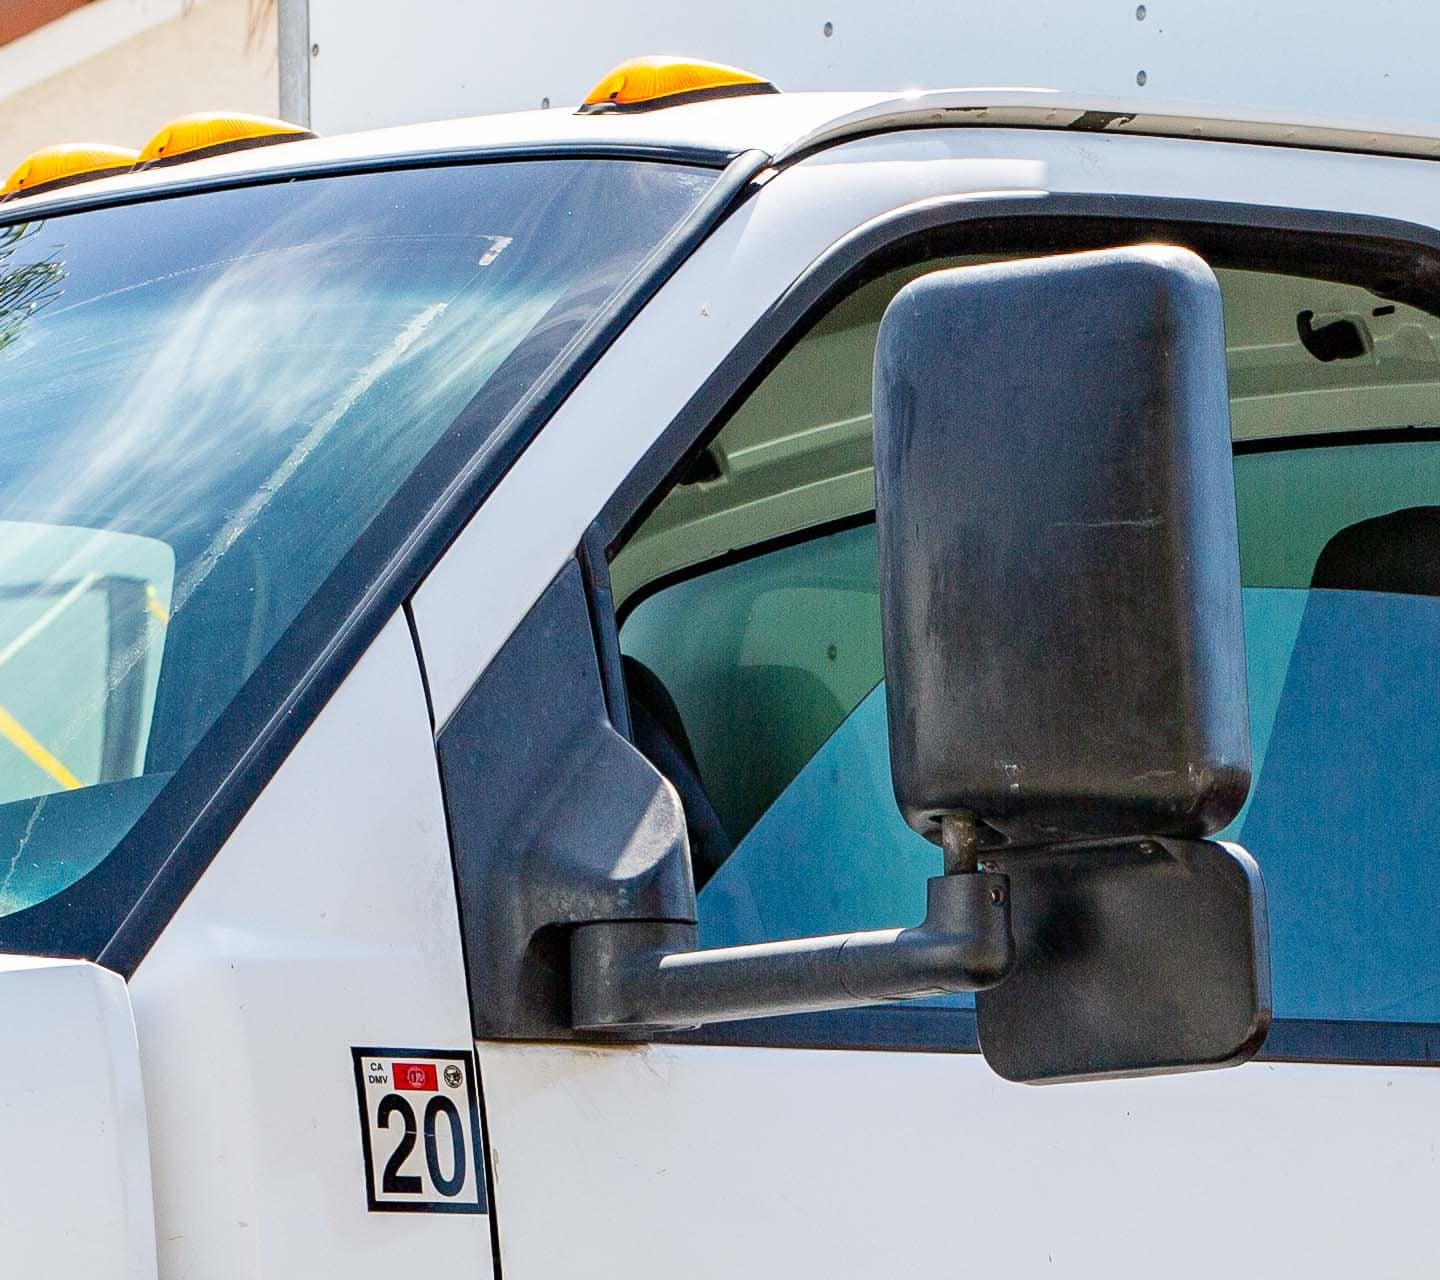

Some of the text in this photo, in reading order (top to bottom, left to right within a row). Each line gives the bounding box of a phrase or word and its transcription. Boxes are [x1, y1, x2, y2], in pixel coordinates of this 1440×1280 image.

[371, 1062, 384, 1072] CA
[368, 1074, 388, 1084] DMV
[377, 1093, 466, 1197] 20
